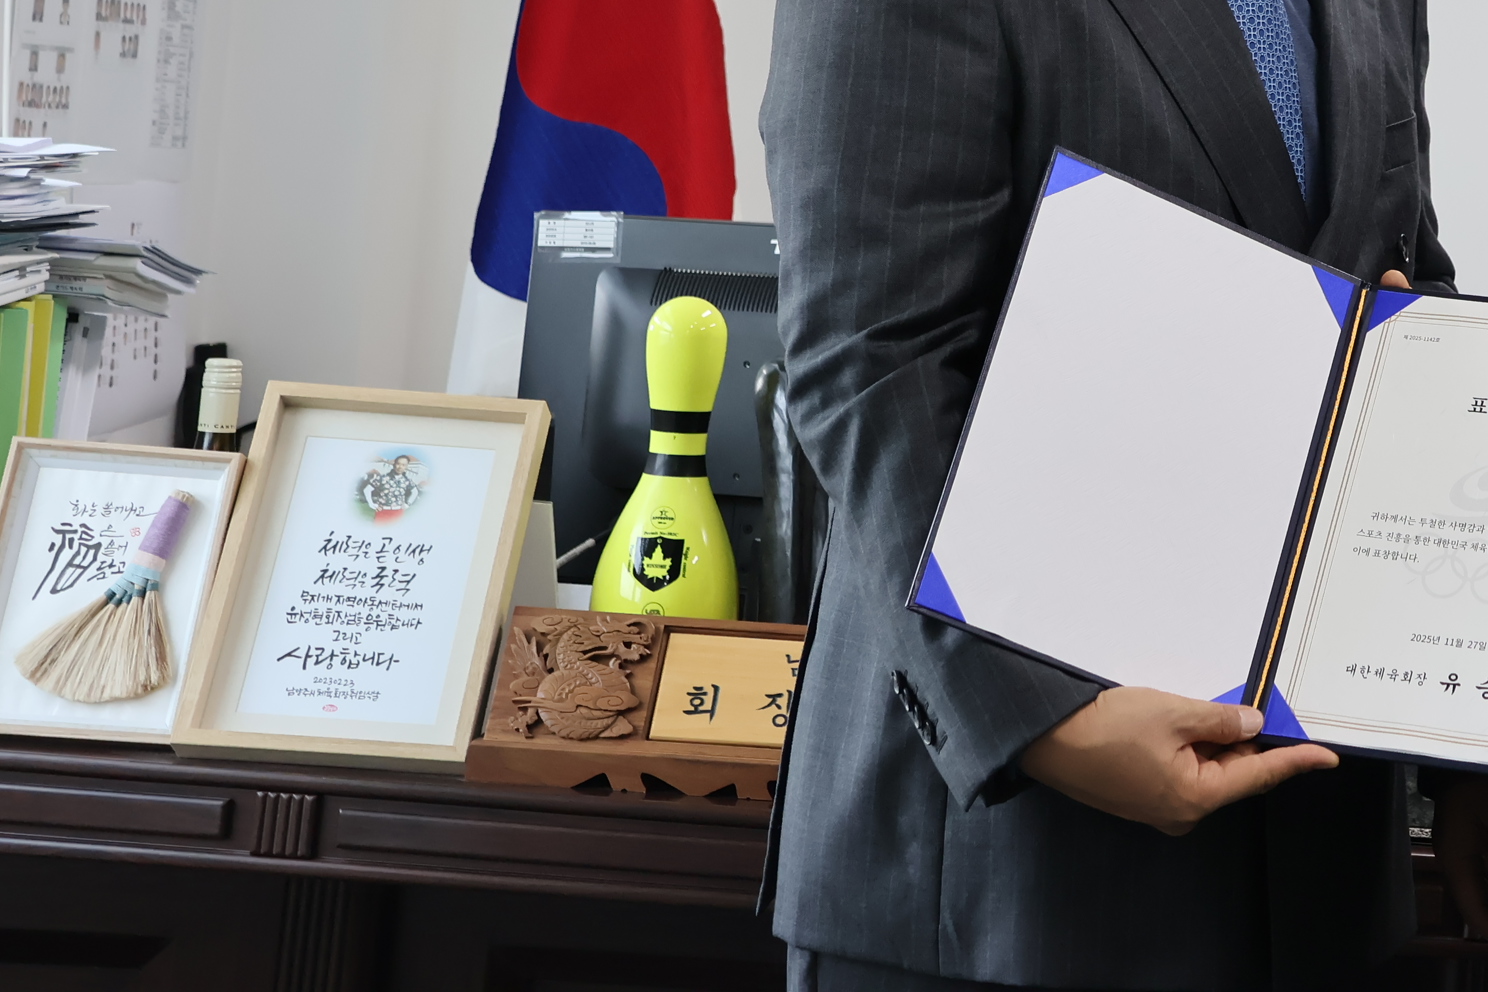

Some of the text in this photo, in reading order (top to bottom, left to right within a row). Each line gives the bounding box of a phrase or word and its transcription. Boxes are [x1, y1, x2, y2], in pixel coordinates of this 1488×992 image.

[1371, 511, 1416, 526] 귀하께서는
[1418, 517, 1446, 530] 투철한
[1448, 520, 1485, 534] 사명감과
[318, 531, 371, 562] 체력은
[1356, 528, 1383, 539] 스포츠
[1386, 532, 1412, 544] 진흥을
[1413, 535, 1431, 546] 통한
[1433, 537, 1468, 550] 대한민국
[1353, 546, 1420, 564] 이에 표창합니다.
[86, 558, 126, 582] 담고
[313, 563, 417, 597] 체력은 국력
[332, 630, 362, 645] 그리고
[1410, 633, 1488, 651] 2025년 11월 27일
[276, 645, 400, 671] 사랑합니다
[1345, 663, 1428, 687] 대한체육회장
[1439, 672, 1461, 695] 유
